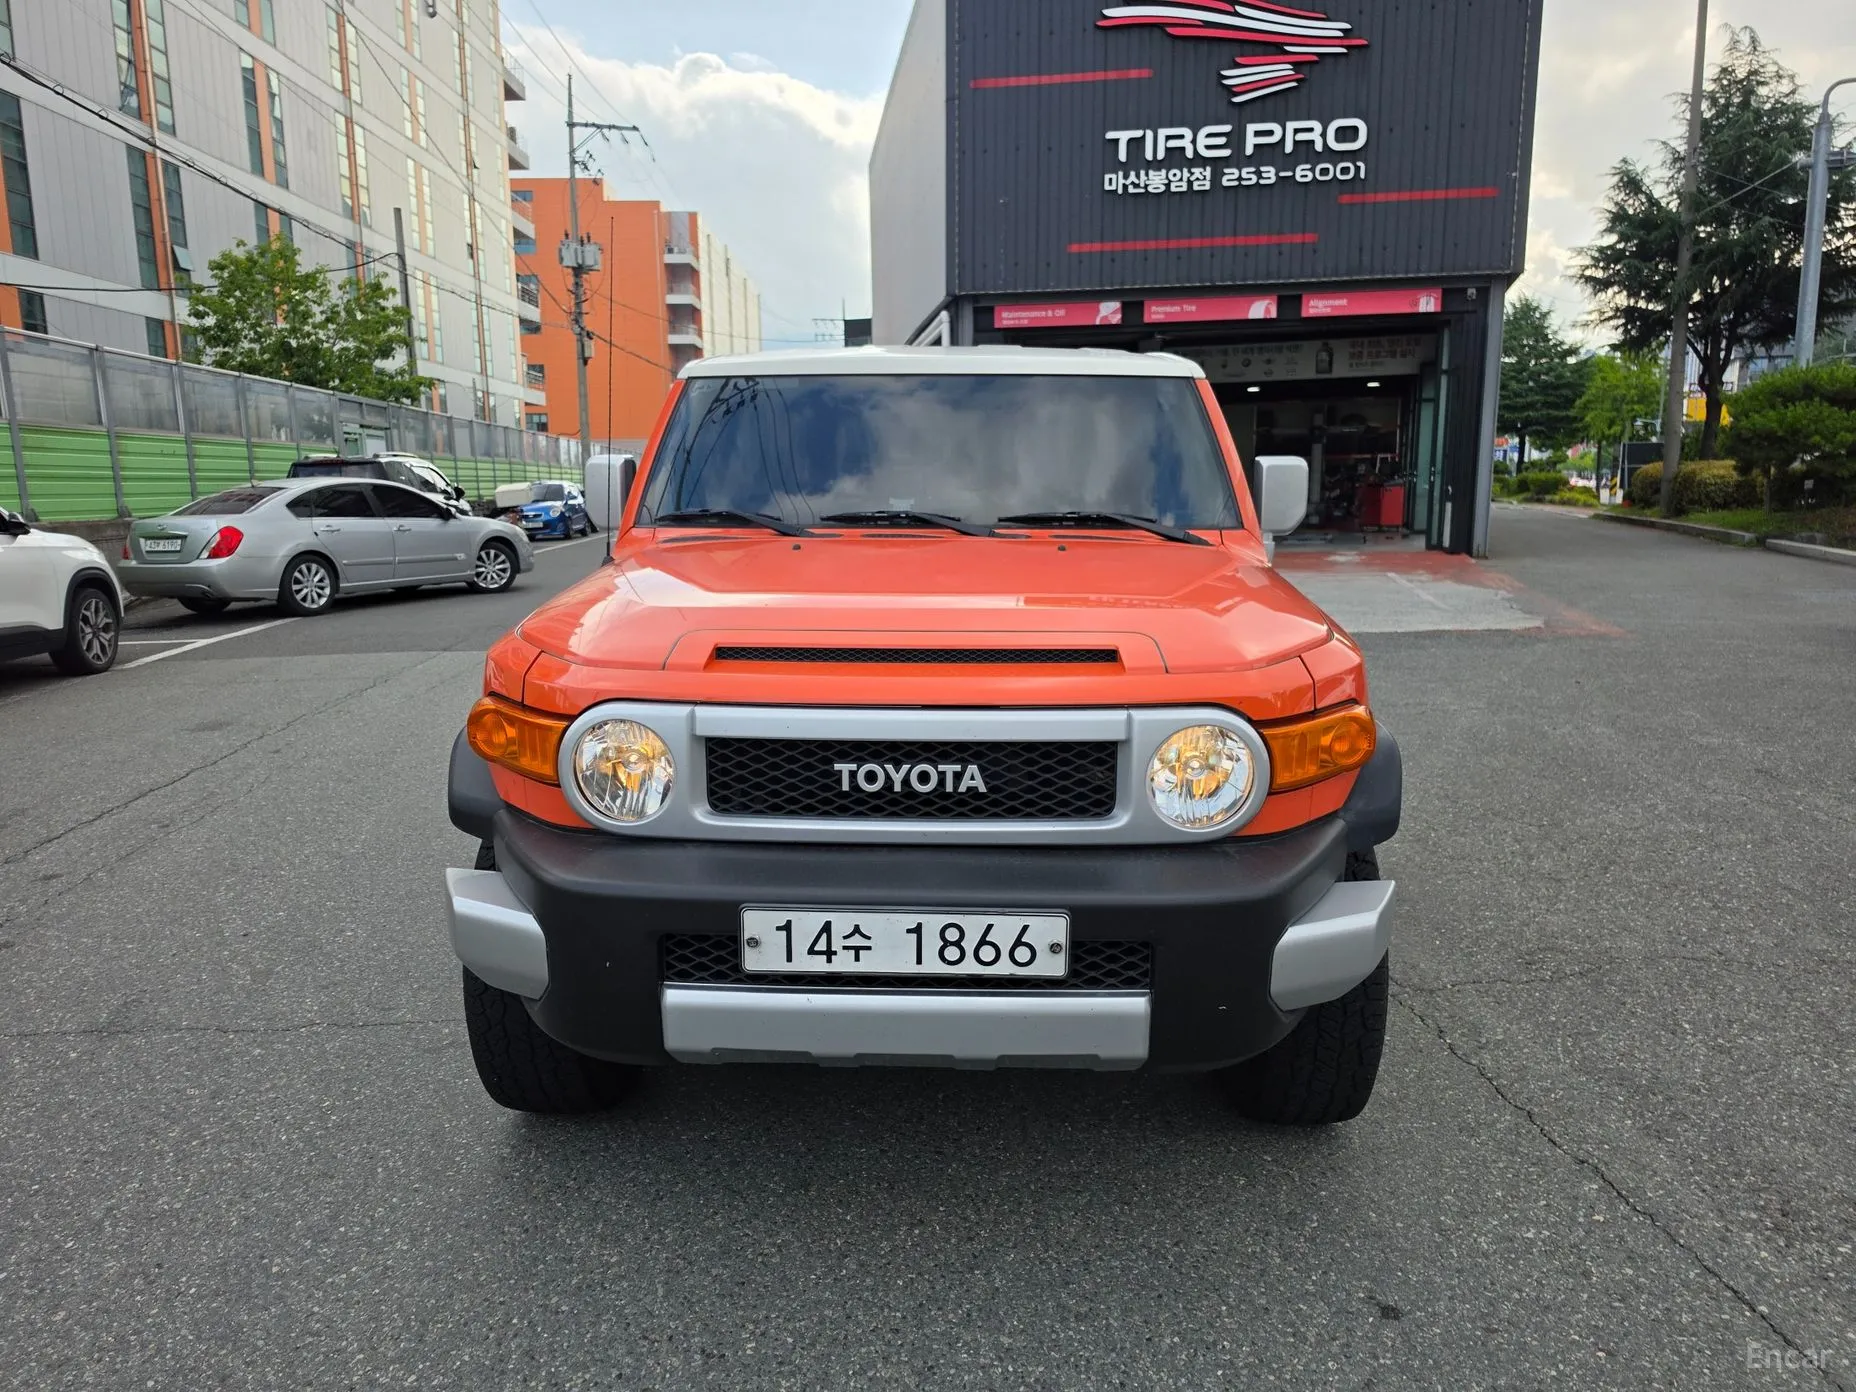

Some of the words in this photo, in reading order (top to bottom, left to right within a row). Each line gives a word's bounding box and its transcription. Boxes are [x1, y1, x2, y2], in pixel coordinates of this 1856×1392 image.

[1104, 123, 1233, 163] TIRE
[1244, 117, 1369, 157] PRO
[1103, 165, 1212, 195] 마산봉암점
[1221, 161, 1367, 187] 253-6001
[1150, 304, 1181, 313] Premium
[1182, 303, 1197, 312] Tire
[1308, 298, 1348, 308] Alignment
[833, 763, 988, 793] TOYOTA
[775, 918, 873, 965] 14수
[905, 921, 1038, 968] 1866
